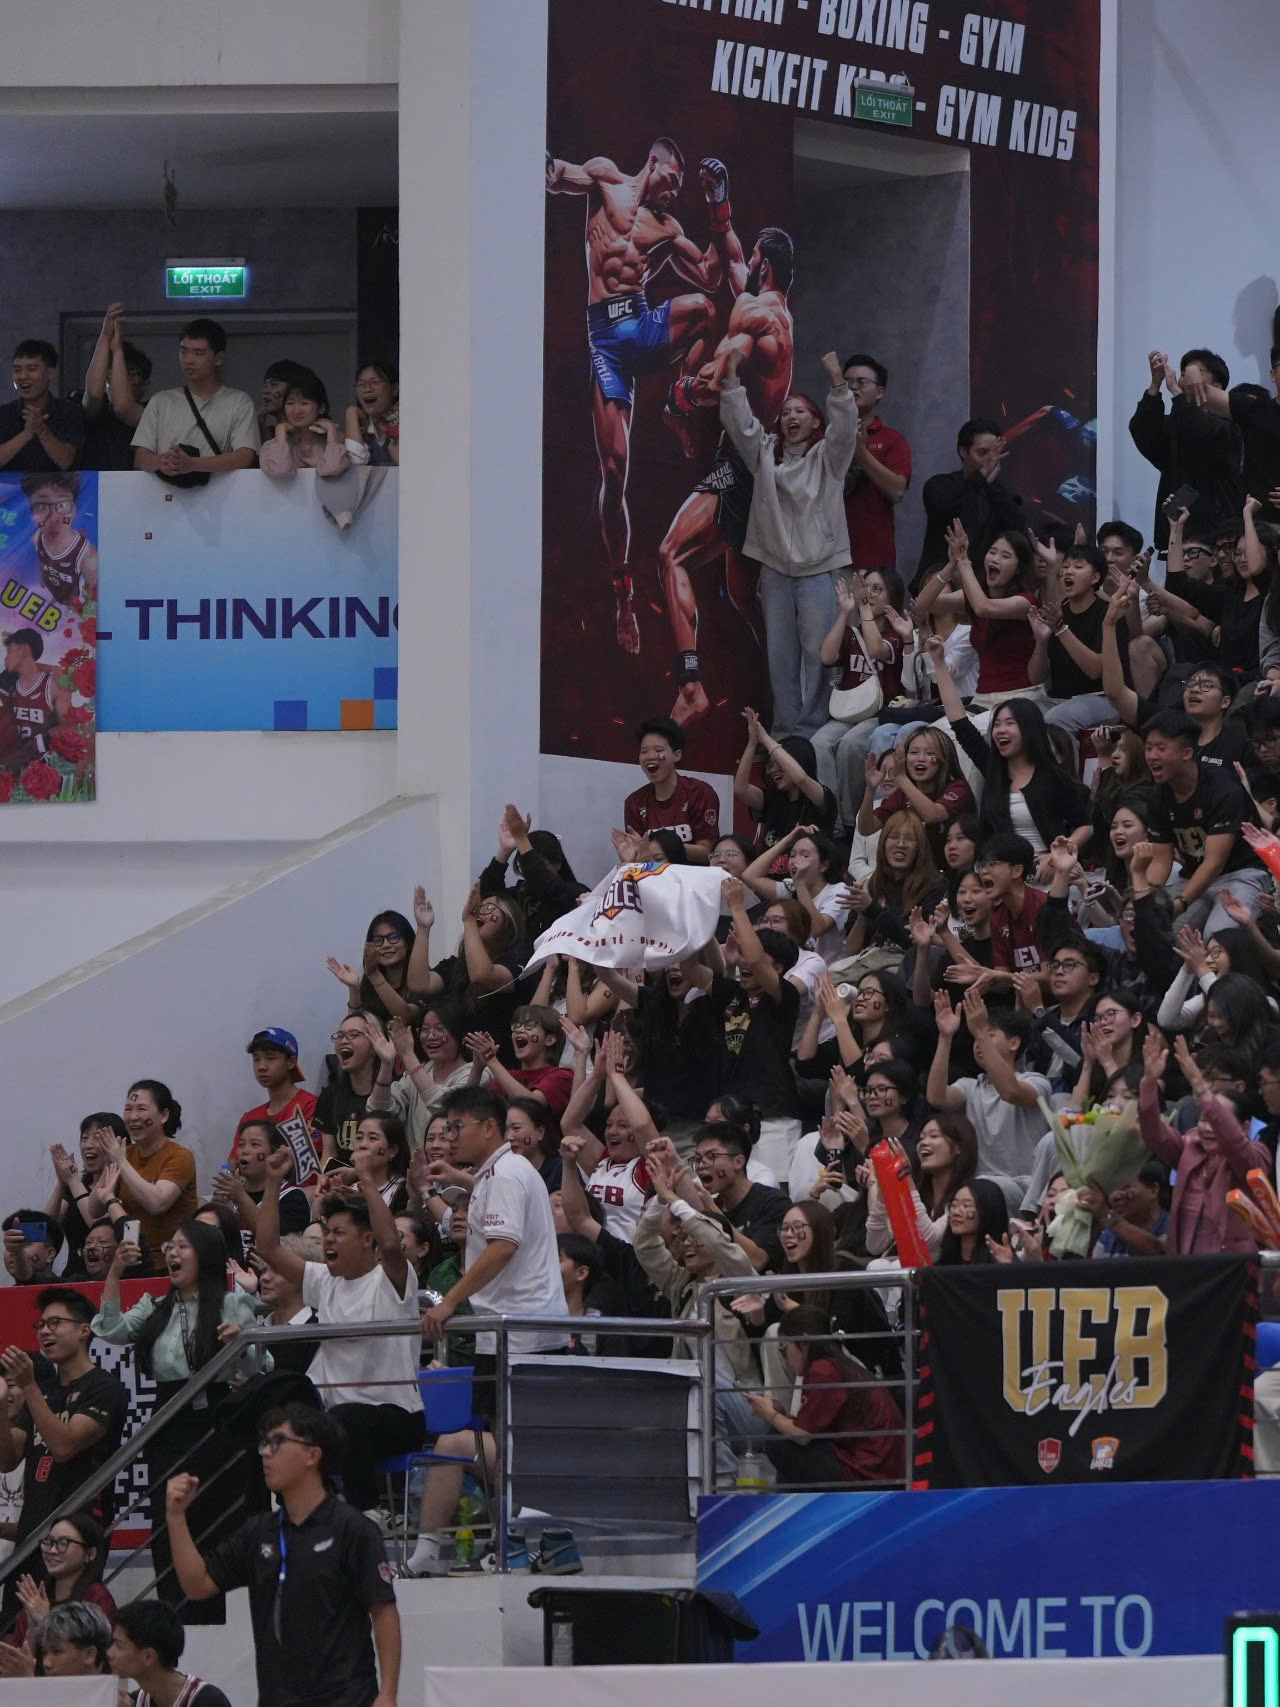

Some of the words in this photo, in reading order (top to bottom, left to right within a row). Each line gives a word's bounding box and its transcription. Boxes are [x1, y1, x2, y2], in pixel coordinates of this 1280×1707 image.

[817, 0, 929, 55] BOXING
[959, 13, 1027, 76] GYM
[711, 39, 828, 111] KICKFIT
[872, 109, 897, 121] EXIT
[936, 85, 1002, 147] GYM
[1008, 99, 1078, 161] KIDS
[189, 285, 222, 294] EXIT
[607, 299, 633, 319] UFC
[1, 579, 62, 632] UEB
[125, 597, 398, 640] THINKIN
[14, 707, 45, 723] EB
[281, 1119, 318, 1183] EAGLES
[588, 1184, 625, 1207] EB
[997, 1286, 1169, 1412] UEB
[1022, 1355, 1139, 1437] Eagles
[35, 1456, 53, 1482] 6
[797, 1596, 1069, 1662] WELCOME
[1081, 1593, 1153, 1657] TO
